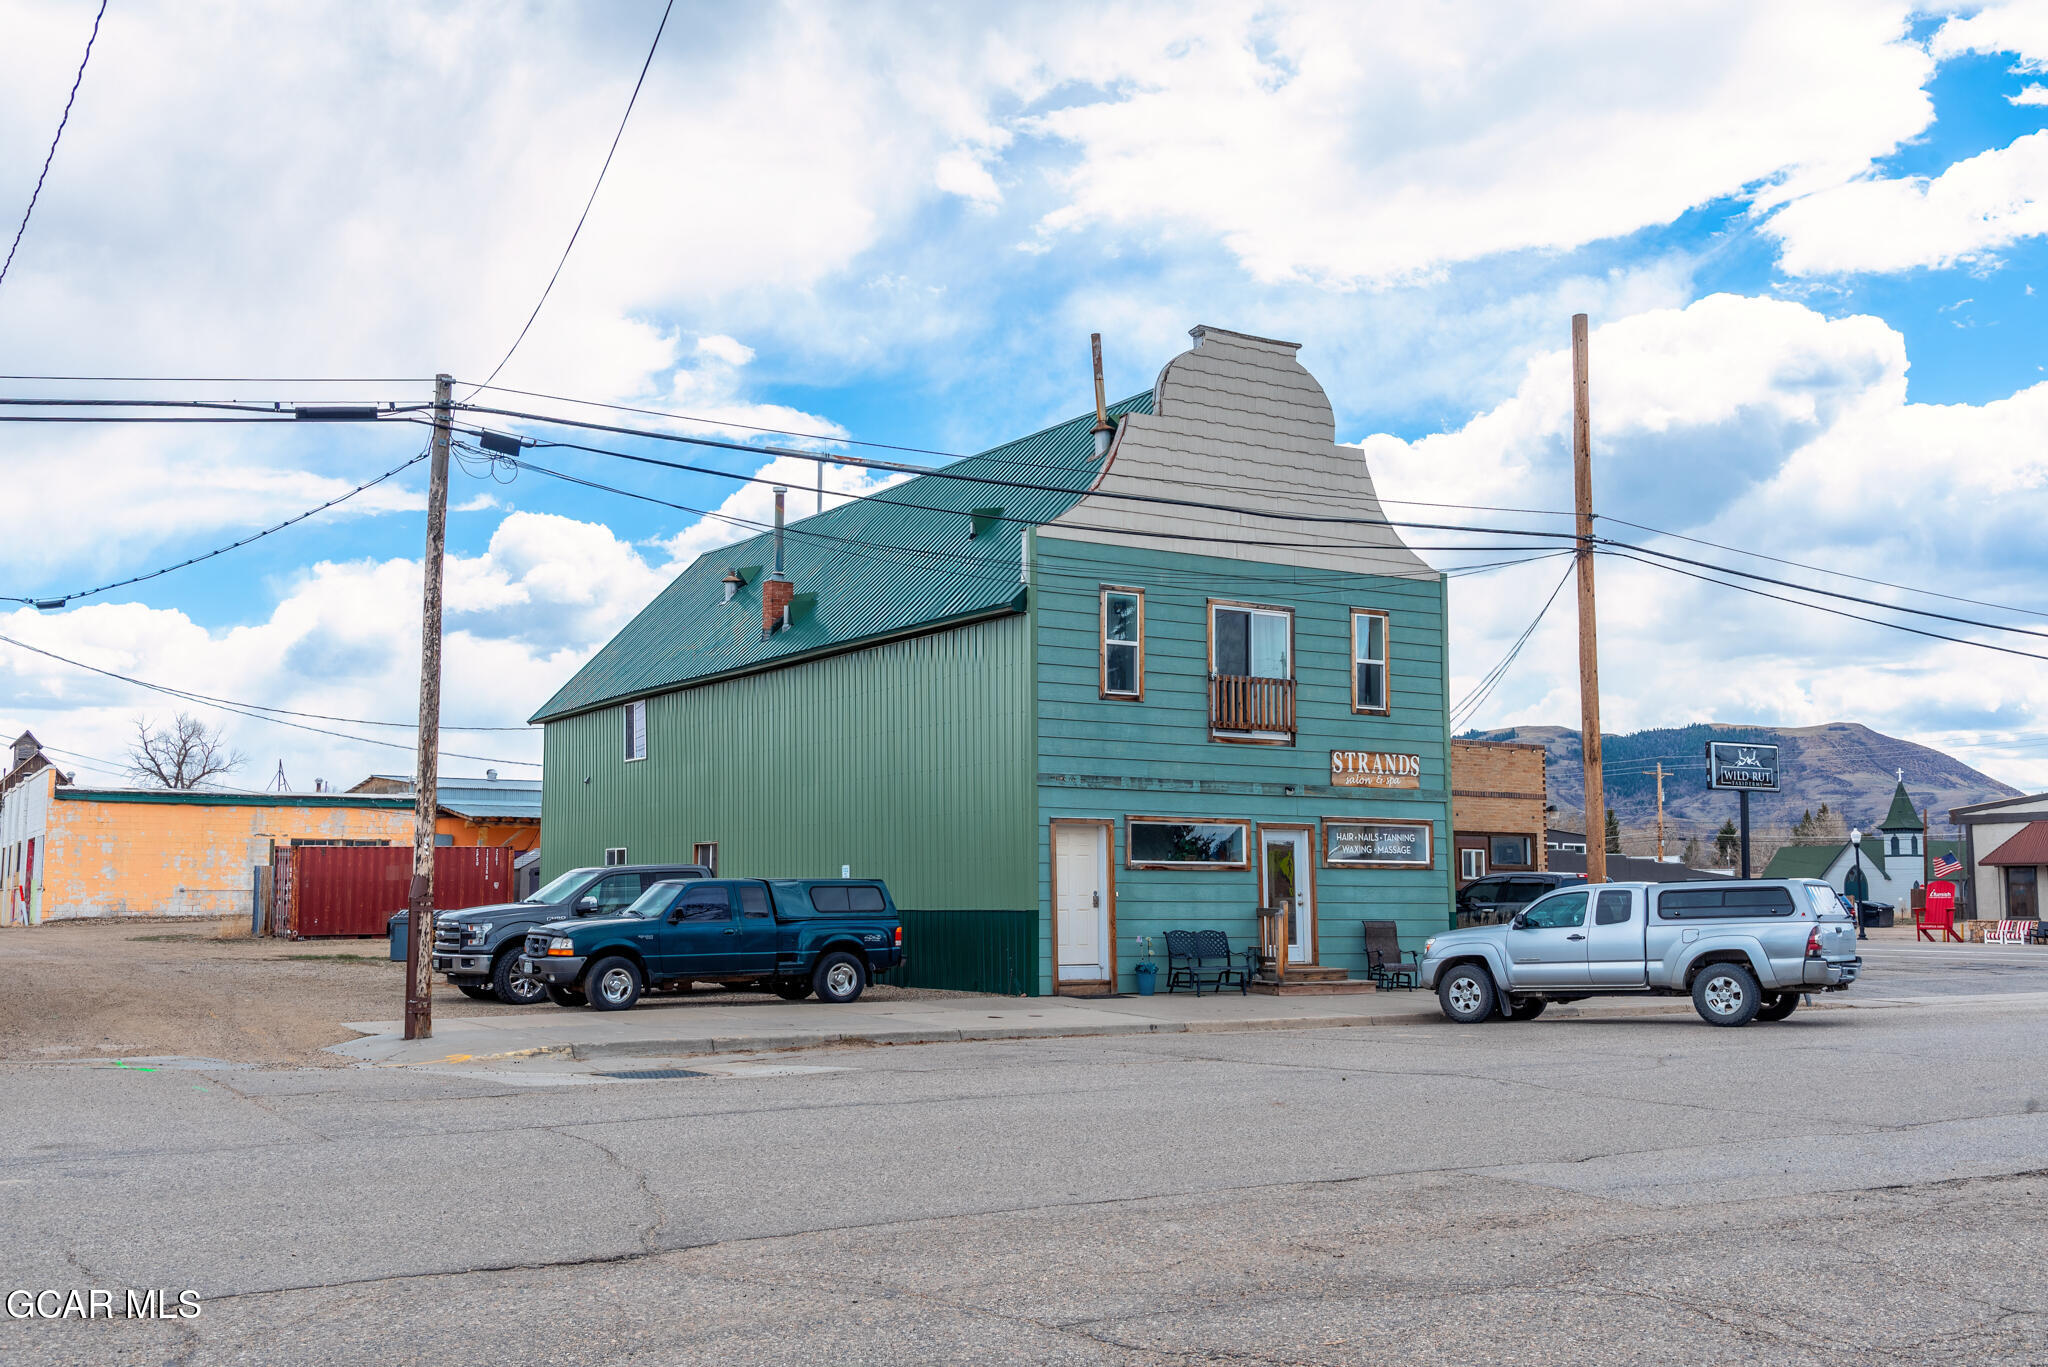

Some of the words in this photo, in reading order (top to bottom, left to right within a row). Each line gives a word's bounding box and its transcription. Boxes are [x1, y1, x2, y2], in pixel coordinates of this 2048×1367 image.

[1333, 752, 1420, 776] STRANDS
[1345, 774, 1373, 785] salon
[1376, 774, 1385, 785] &
[1386, 776, 1401, 786] spa
[1724, 770, 1749, 781] WILD
[1752, 771, 1771, 782] RUT
[1336, 832, 1354, 841] HAIR
[1357, 833, 1379, 842] NAILS
[1383, 833, 1416, 843] TANNING
[1341, 845, 1373, 854] WAXING
[1377, 845, 1411, 855] MASSAGE
